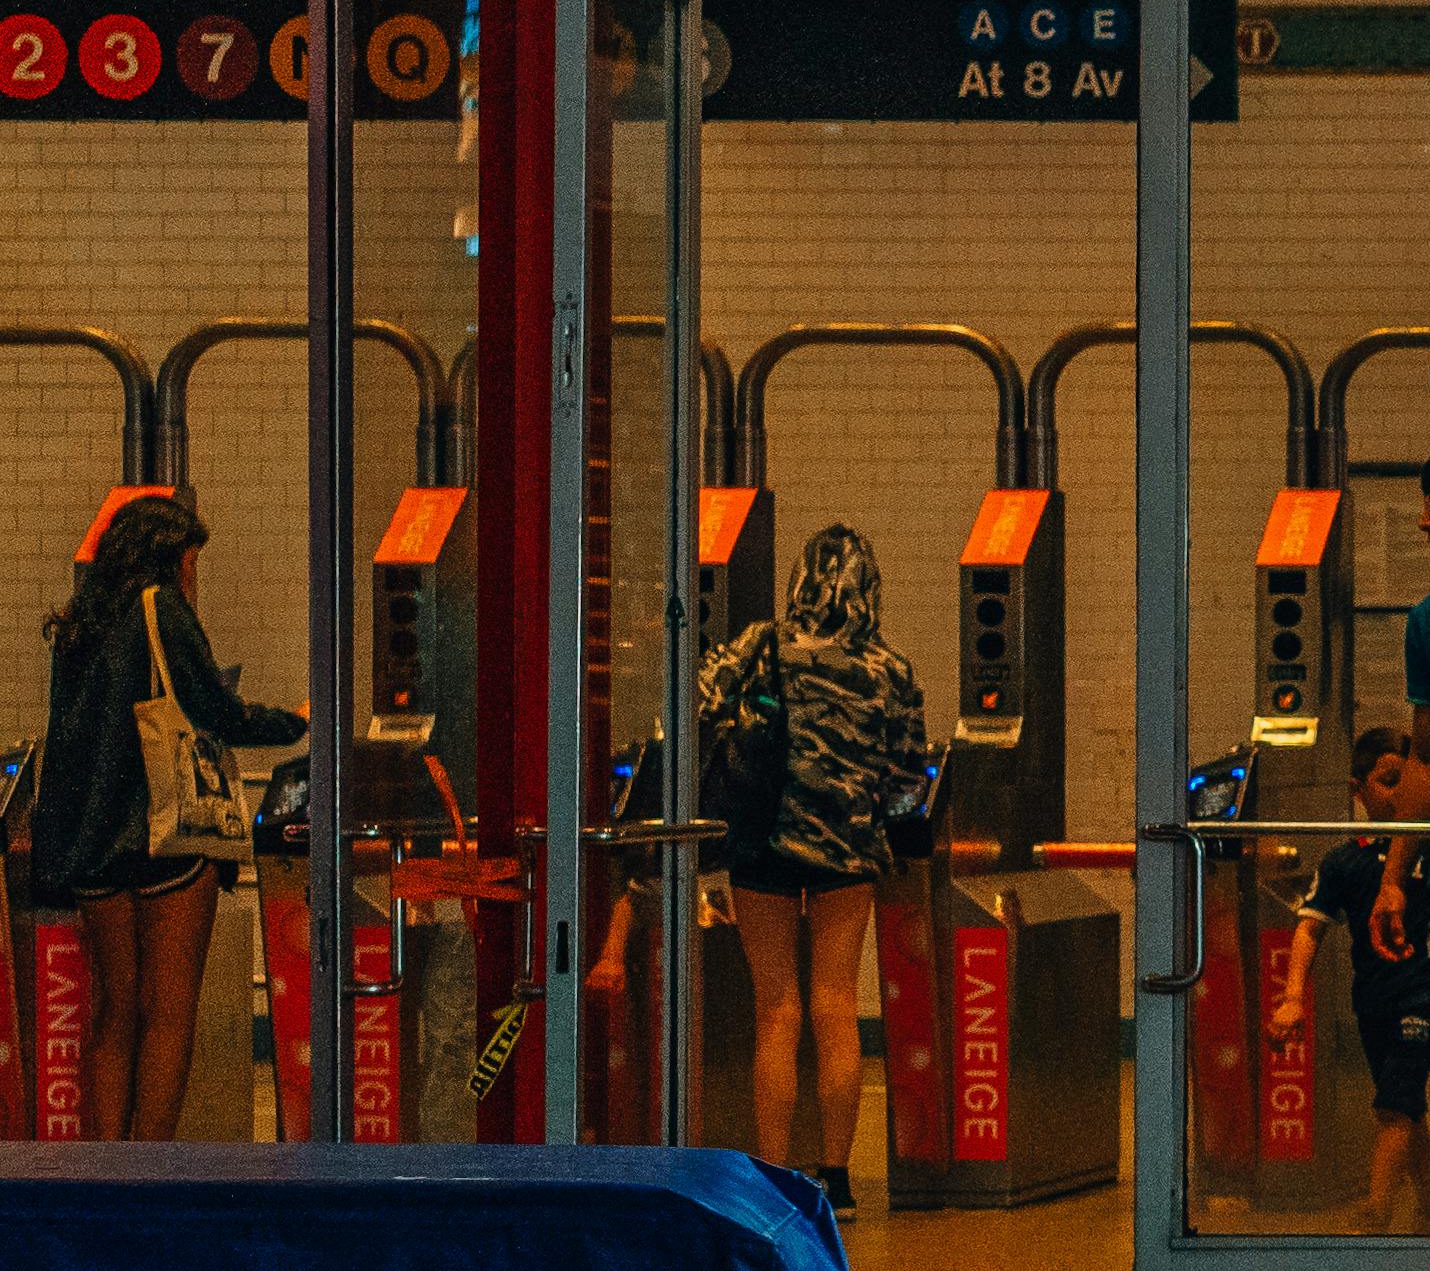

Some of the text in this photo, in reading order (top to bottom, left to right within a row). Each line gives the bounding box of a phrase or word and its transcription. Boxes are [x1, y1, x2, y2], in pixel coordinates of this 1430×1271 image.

[11, 32, 45, 82] 2
[102, 31, 139, 81] 3
[201, 31, 235, 83] 7
[387, 35, 429, 84] Q
[958, 60, 1124, 99] At 8 Av
[970, 9, 1116, 41] A C E
[46, 943, 81, 1138] LANEIGE
[963, 946, 999, 1141] LANEIGE
[1270, 947, 1306, 1140] LEIGE
